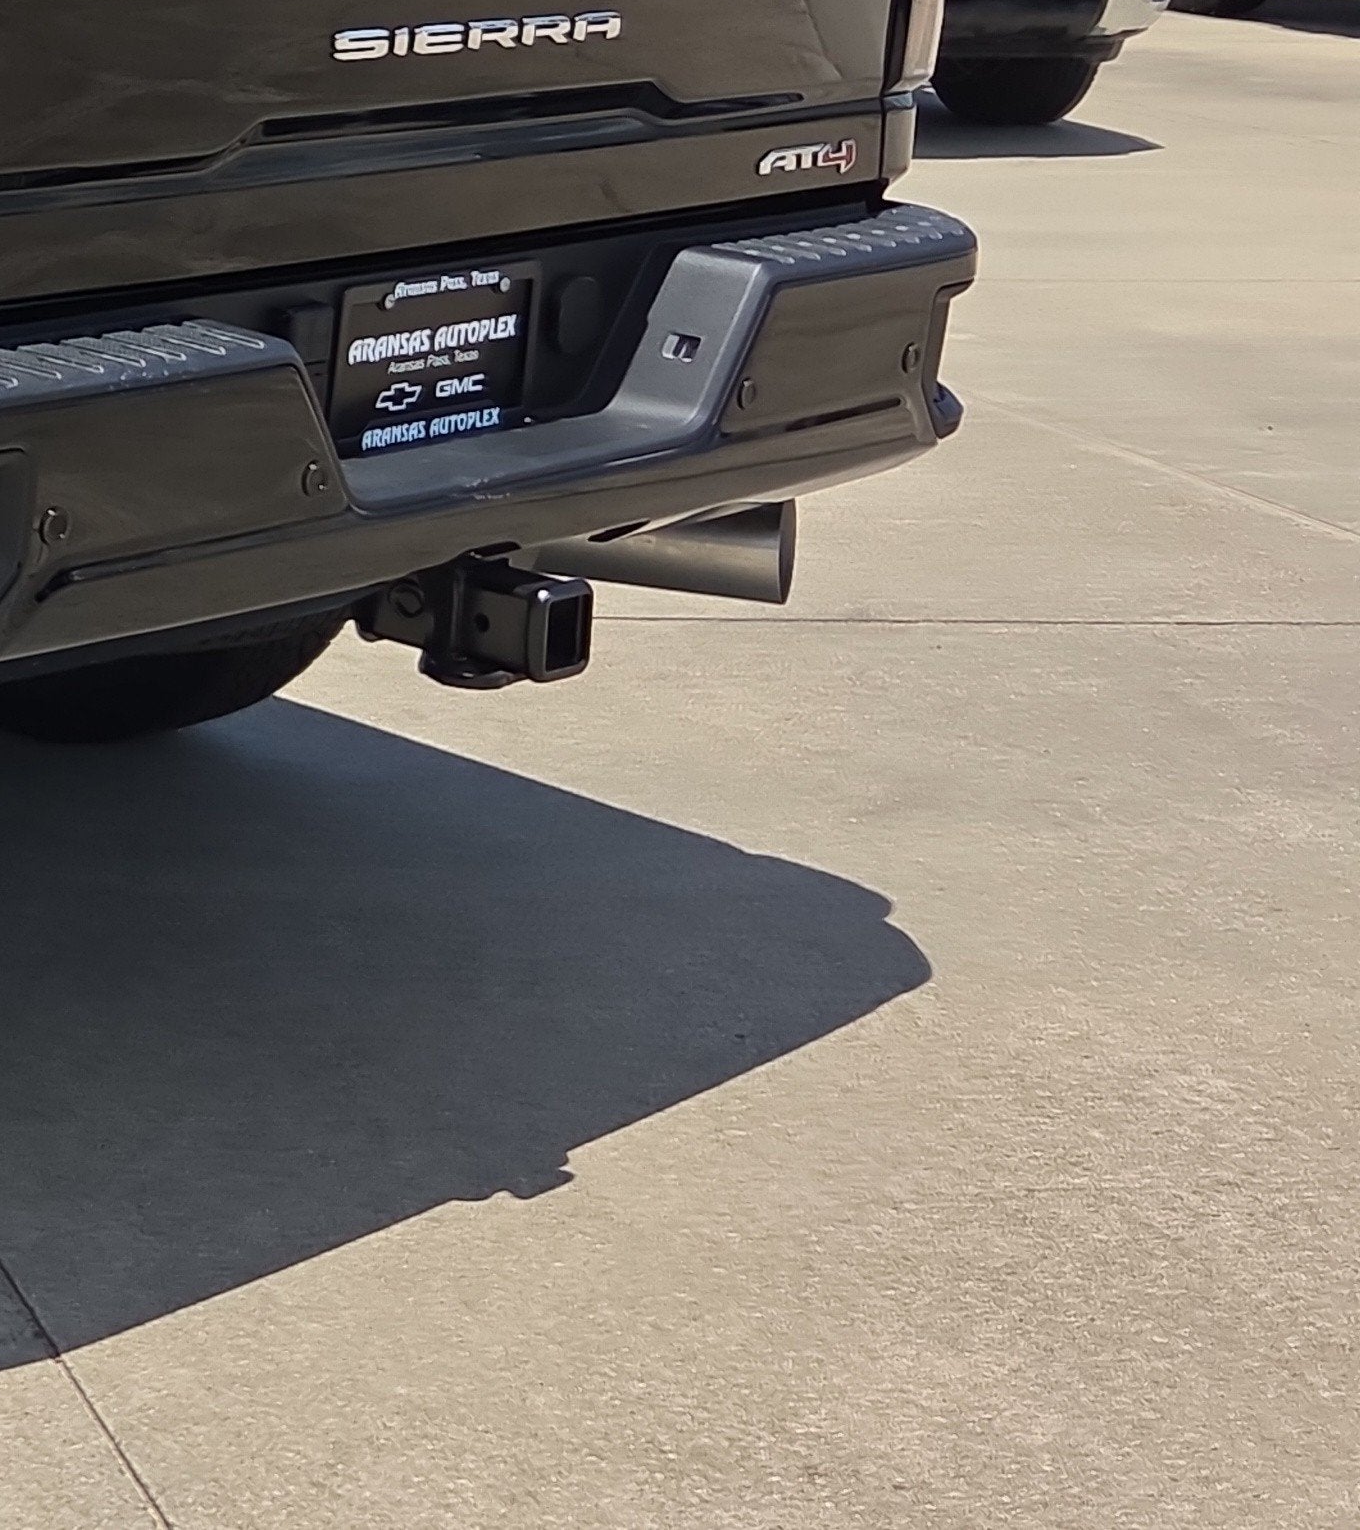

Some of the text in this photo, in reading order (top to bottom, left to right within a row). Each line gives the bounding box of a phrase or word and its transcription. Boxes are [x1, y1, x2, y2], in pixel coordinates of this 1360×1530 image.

[332, 10, 622, 62] SIERRA
[757, 137, 857, 176] AT4
[347, 313, 518, 366] ARANSAS AUTOPLEX
[435, 372, 486, 399] GMC
[361, 406, 501, 452] ARANSAS AUTOPLEX
